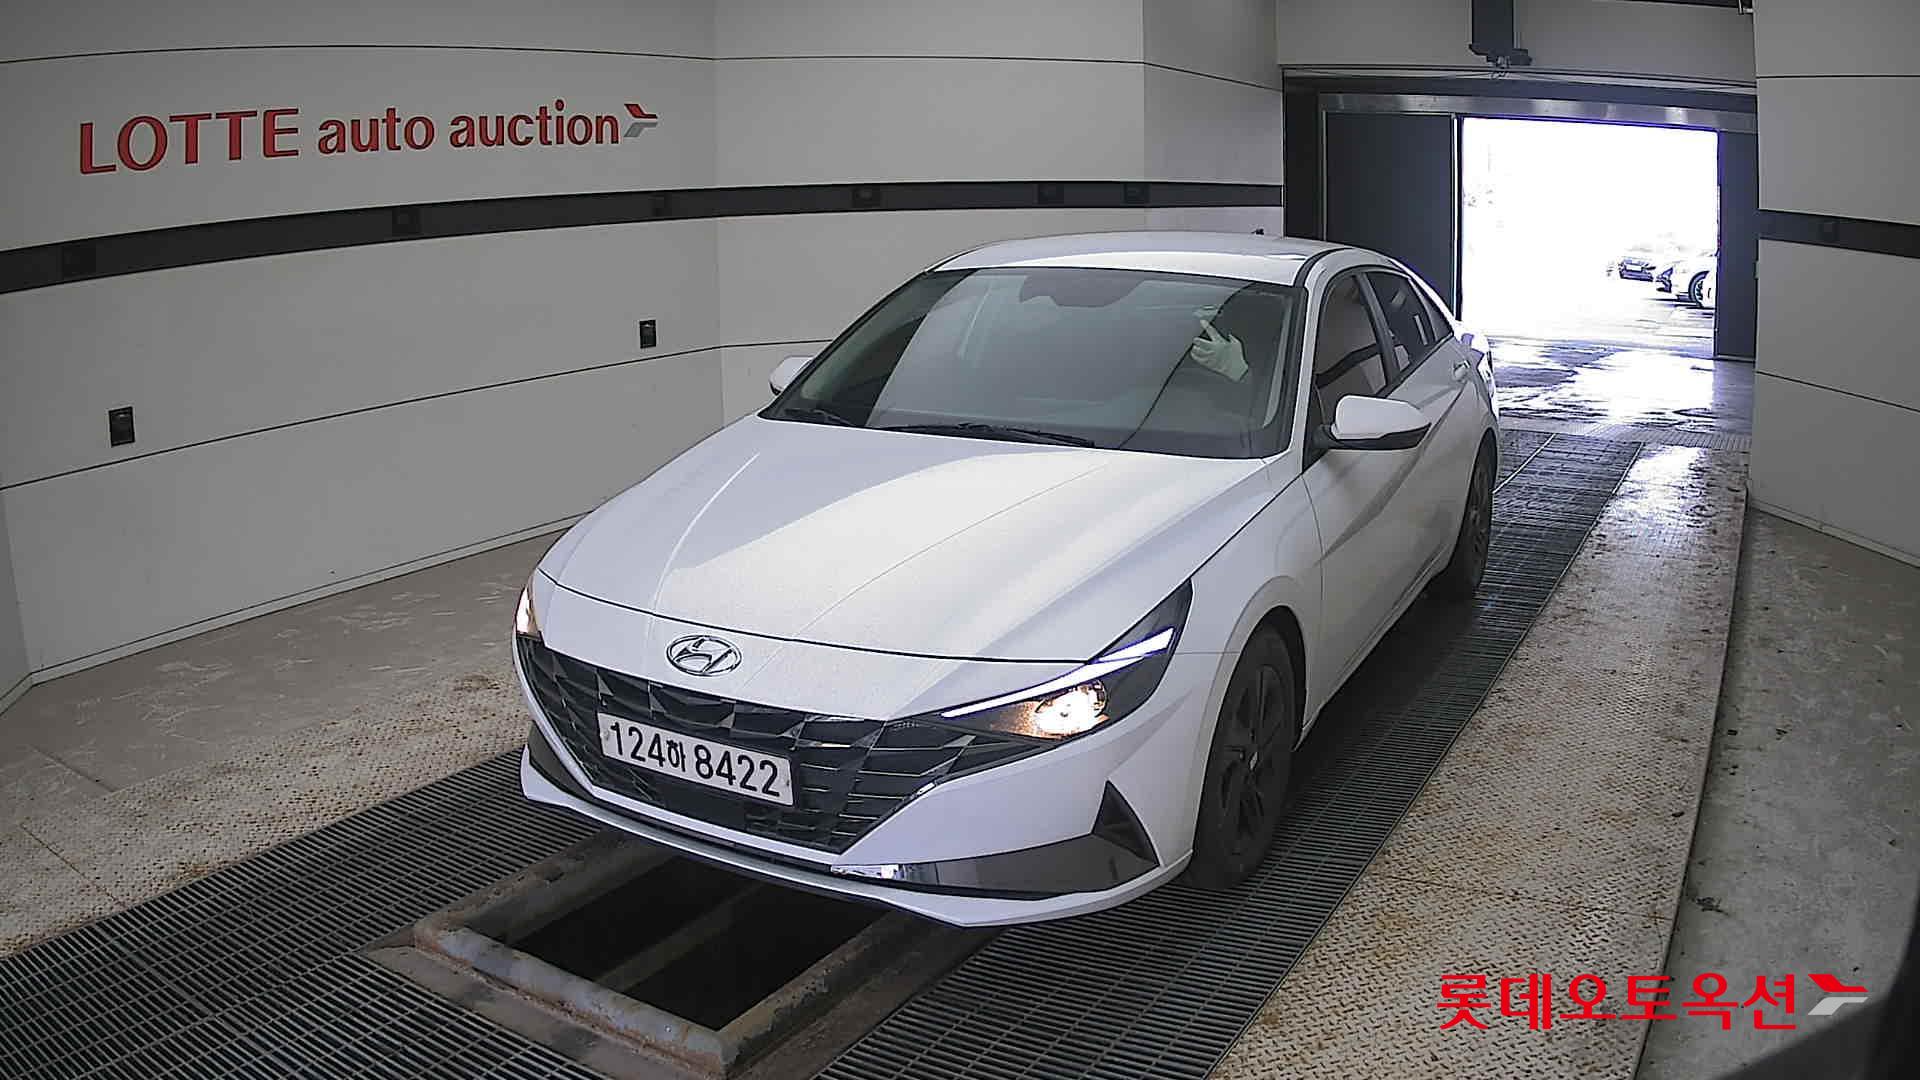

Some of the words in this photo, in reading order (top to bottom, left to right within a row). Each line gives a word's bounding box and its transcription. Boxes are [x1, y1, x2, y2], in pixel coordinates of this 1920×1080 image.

[80, 107, 299, 175] LOTTE
[317, 107, 436, 154] auto
[449, 99, 621, 149] auction
[694, 744, 781, 798] 8422
